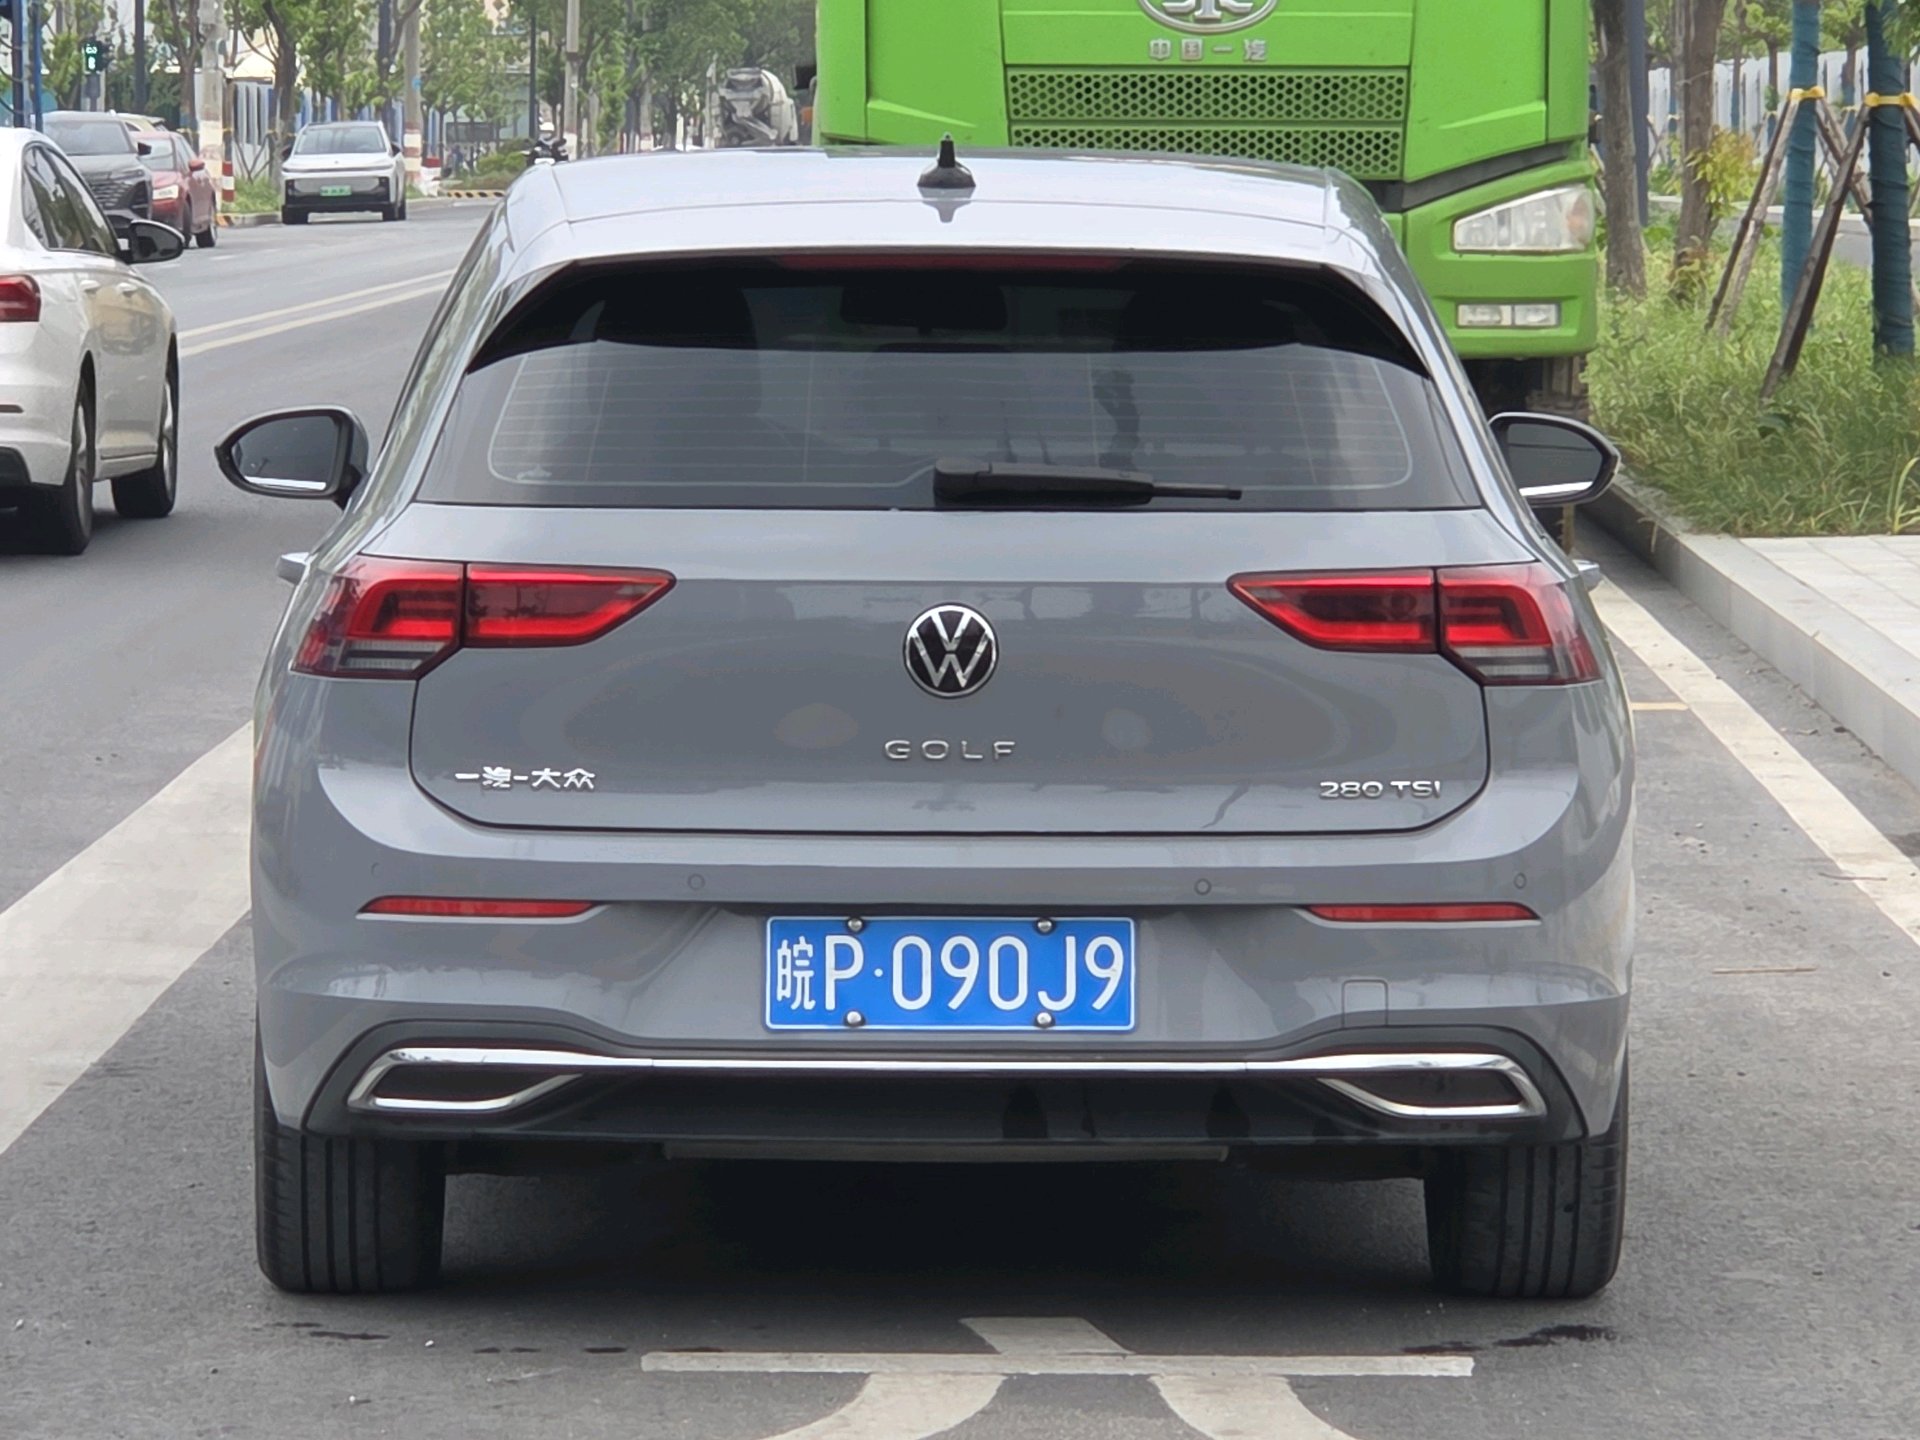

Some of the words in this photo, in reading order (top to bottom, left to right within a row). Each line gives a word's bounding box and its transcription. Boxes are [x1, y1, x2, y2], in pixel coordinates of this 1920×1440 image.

[884, 739, 1016, 760] GOLF
[1320, 781, 1384, 798] 280
[1389, 780, 1441, 799] TSI
